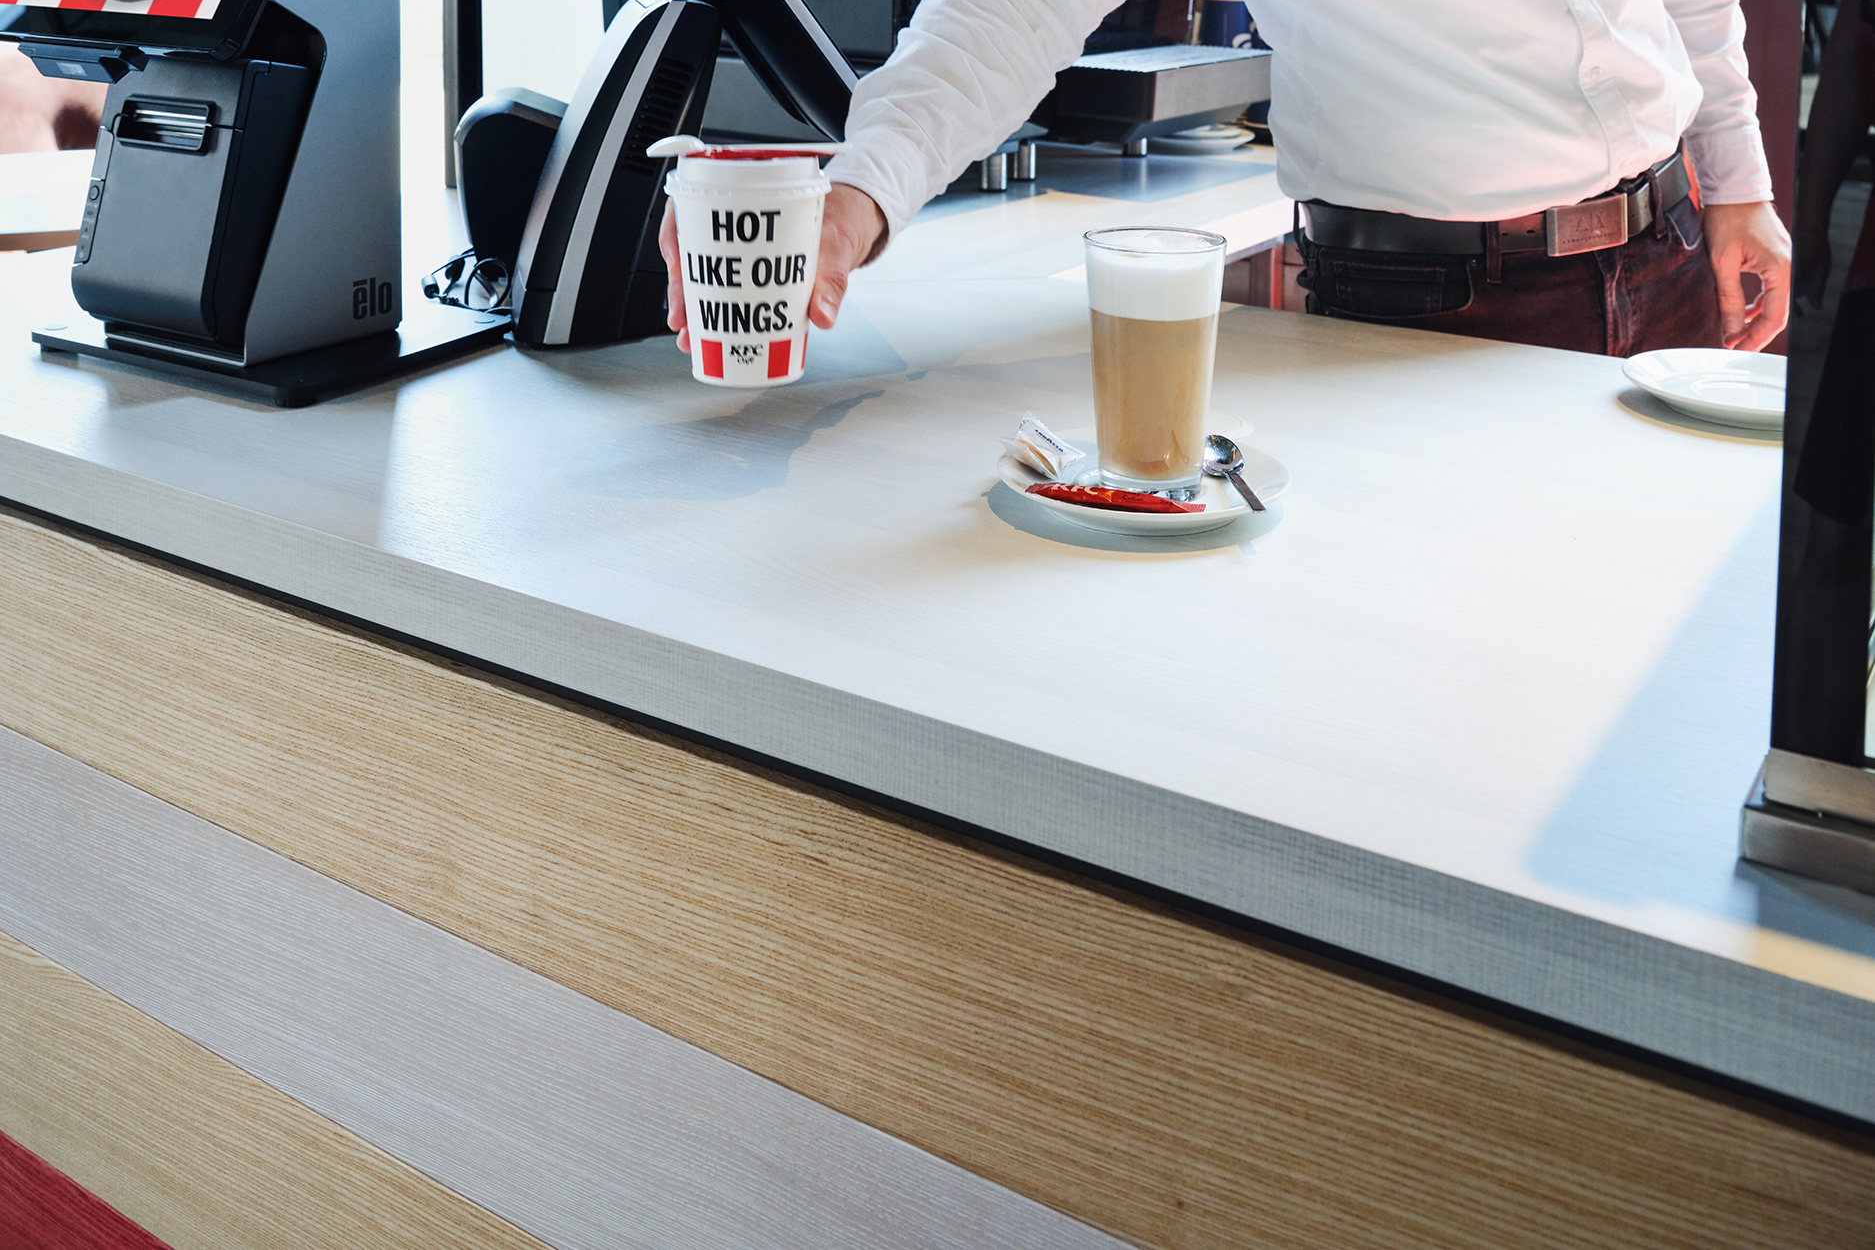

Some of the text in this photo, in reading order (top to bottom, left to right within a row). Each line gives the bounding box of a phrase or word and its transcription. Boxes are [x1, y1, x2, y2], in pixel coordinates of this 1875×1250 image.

[711, 209, 781, 242] HOT
[687, 252, 807, 288] LIKE OUR
[698, 298, 794, 333] WINGS.
